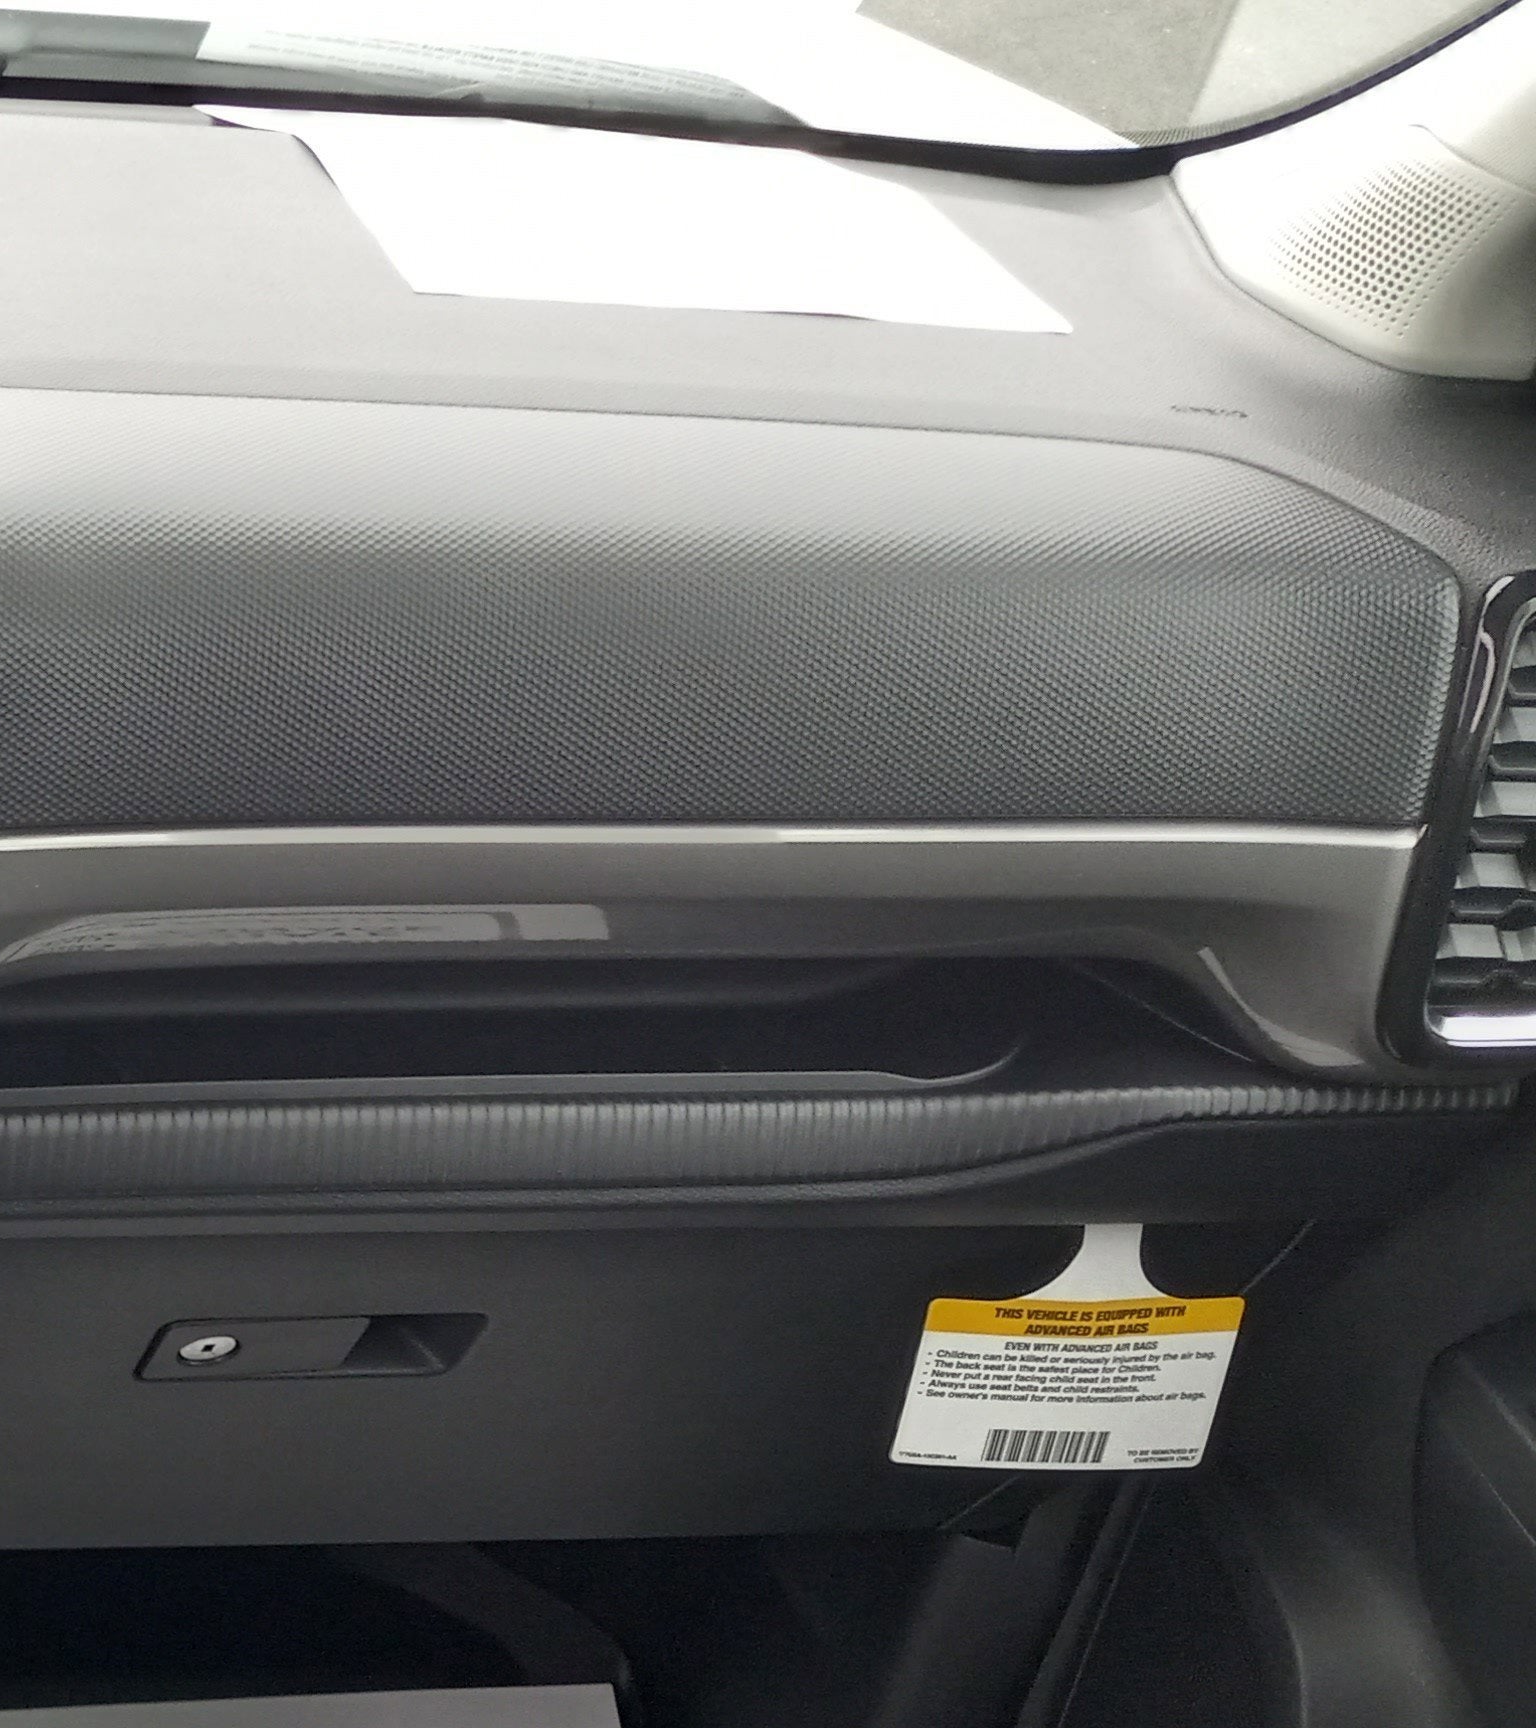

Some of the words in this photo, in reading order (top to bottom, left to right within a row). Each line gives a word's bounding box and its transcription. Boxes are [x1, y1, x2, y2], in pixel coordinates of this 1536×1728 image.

[995, 1307, 1022, 1319] THIS
[1027, 1309, 1079, 1321] VEHICLE
[1080, 1311, 1093, 1321] IS
[1096, 1307, 1152, 1321] EQUIPPED
[1155, 1306, 1186, 1317] WITH
[1024, 1324, 1091, 1337] ADVANCED
[1094, 1325, 1114, 1336] AIR
[1118, 1323, 1149, 1334] BAGS
[1004, 1342, 1030, 1351] EVEN
[1033, 1343, 1059, 1352] WITH
[1061, 1343, 1112, 1352] ADVANCED
[1114, 1342, 1131, 1351] AIR
[1133, 1341, 1158, 1351] BAGS
[936, 1349, 980, 1360] Children
[1004, 1352, 1017, 1362] be
[1019, 1353, 1048, 1363] killed
[1064, 1356, 1109, 1366] seriously
[1112, 1354, 1146, 1365] injured
[1148, 1354, 1160, 1364] by
[1162, 1353, 1178, 1361] the
[1180, 1352, 1193, 1360] air
[934, 1360, 954, 1368] The
[955, 1361, 980, 1370] back
[983, 1363, 1005, 1371] seat
[1019, 1364, 1035, 1372] the
[1038, 1364, 1069, 1373] safest
[1071, 1365, 1099, 1375] place
[931, 1370, 962, 1379] Never
[964, 1372, 981, 1381] put
[1015, 1374, 1047, 1384] facing
[1049, 1375, 1075, 1384] child
[1077, 1376, 1099, 1384] seat
[1113, 1375, 1129, 1383] the
[928, 1380, 966, 1390] Always
[989, 1383, 1011, 1391] seat
[1014, 1383, 1038, 1392] belts
[1040, 1384, 1061, 1392] and
[1063, 1384, 1088, 1393] child
[926, 1389, 946, 1398] See
[948, 1391, 988, 1400] owner's
[991, 1393, 1028, 1401] manual
[1030, 1393, 1044, 1401] for
[1076, 1394, 1133, 1403] information
[1135, 1393, 1163, 1402] about
